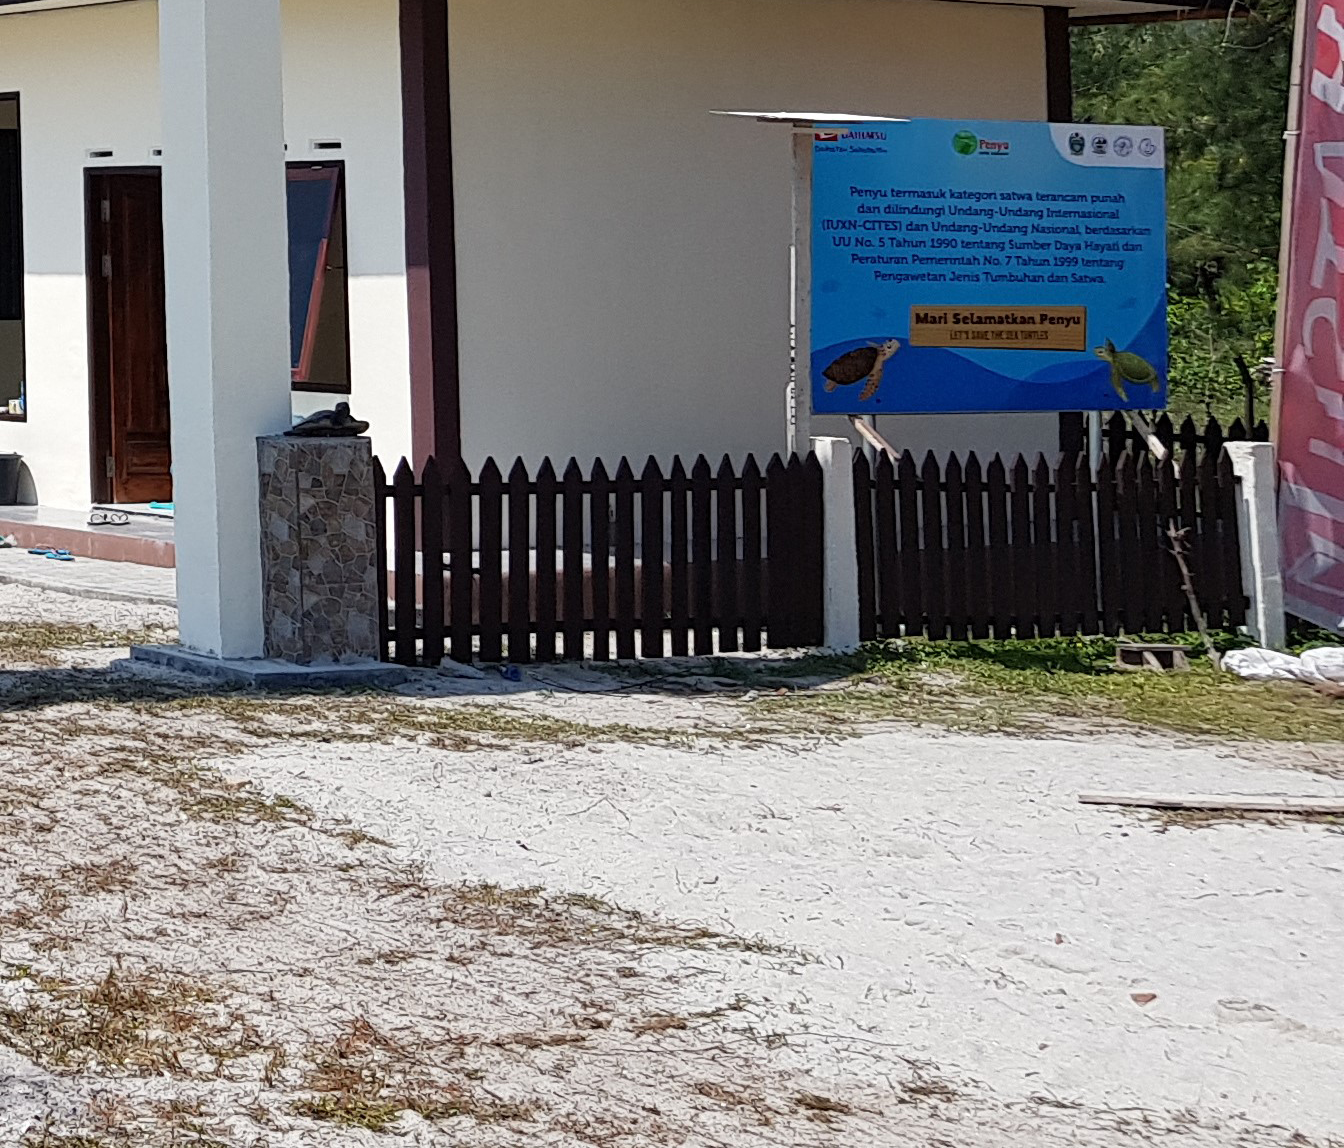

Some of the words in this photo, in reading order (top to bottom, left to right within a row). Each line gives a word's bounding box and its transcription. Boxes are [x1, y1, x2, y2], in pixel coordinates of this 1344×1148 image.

[850, 186, 888, 199] Penyu
[891, 188, 946, 199] termasuk
[949, 189, 997, 202] kategori
[1000, 192, 1032, 201] satwa
[1036, 192, 1088, 202] terancam
[1091, 194, 1125, 204] punah
[857, 204, 880, 214] dan
[884, 204, 945, 218] dilindungi
[948, 205, 1044, 219] Undang-Undang
[1047, 208, 1120, 219] Internasional
[906, 221, 928, 232] dan
[931, 222, 1028, 235] Undang-Undang
[1085, 225, 1152, 236] berdasarkan
[832, 236, 851, 247] UU
[855, 237, 874, 248] No.
[878, 237, 886, 248] 5
[888, 237, 926, 248] Tahun
[930, 238, 957, 248] 1990
[961, 239, 1005, 251] tentang
[1009, 239, 1051, 251] Sumber
[1054, 240, 1081, 253] Daya
[1085, 241, 1119, 253] Hayati
[1122, 242, 1142, 251] dan
[851, 254, 908, 265] Peraturan
[912, 254, 980, 266] Pemerintah
[983, 255, 1001, 266] No.
[1005, 256, 1014, 266] 7
[1016, 256, 1050, 267] Tahun
[1054, 257, 1079, 267] 1999
[1082, 257, 1125, 270] tentang
[874, 270, 946, 283] Pengawetan
[949, 271, 979, 282] Jenis
[985, 272, 1043, 283] Tumbuhan
[1048, 272, 1068, 283] dan
[915, 313, 947, 324] Mari
[953, 313, 1035, 325] Selamatkan
[1040, 314, 1080, 327] Penyu
